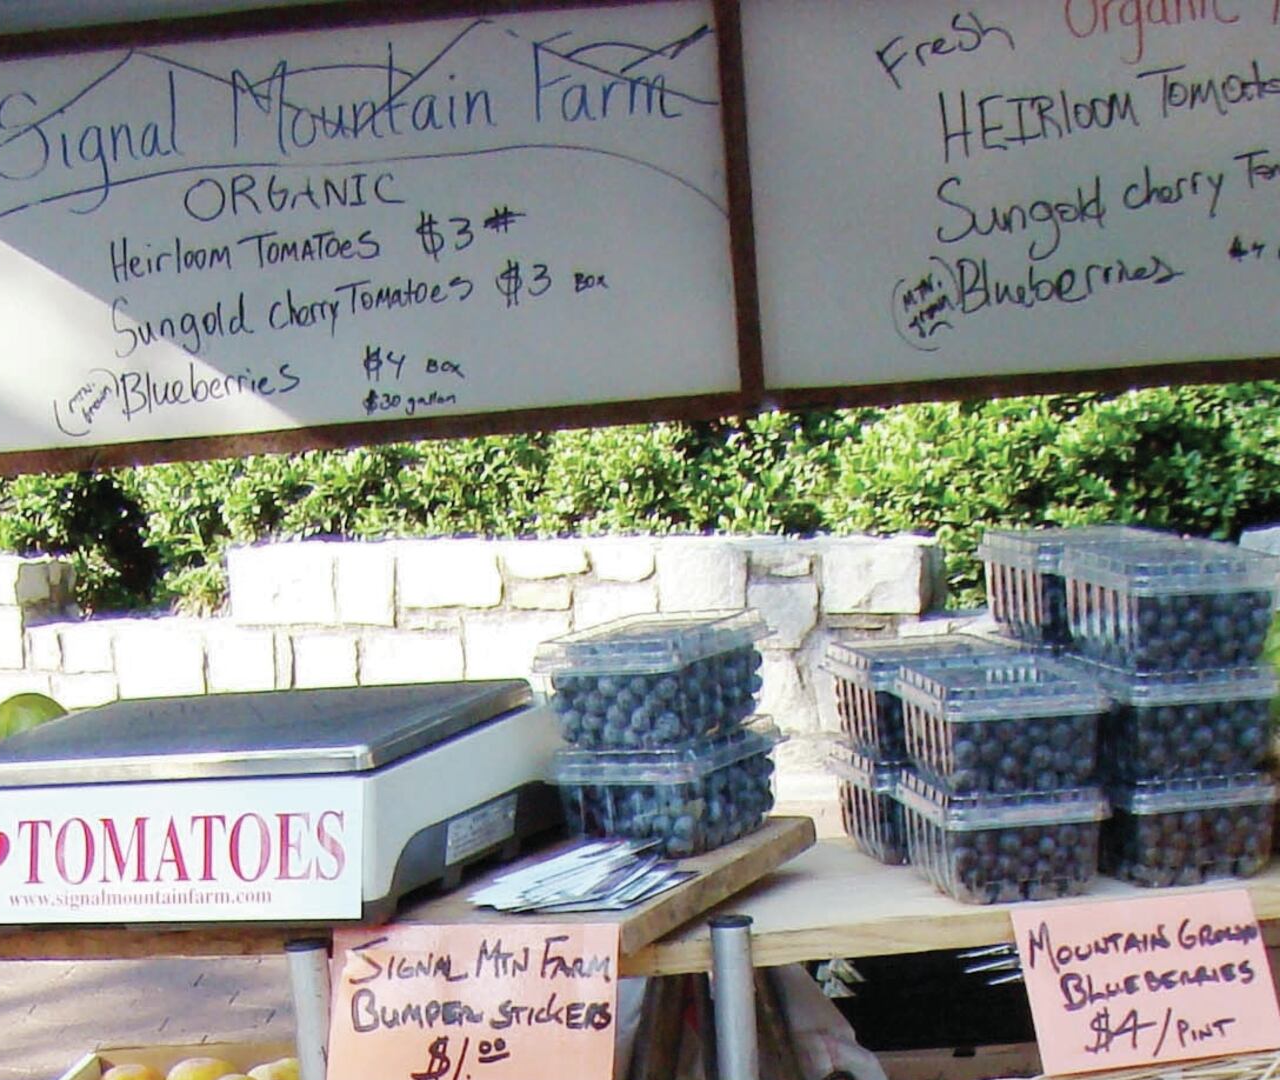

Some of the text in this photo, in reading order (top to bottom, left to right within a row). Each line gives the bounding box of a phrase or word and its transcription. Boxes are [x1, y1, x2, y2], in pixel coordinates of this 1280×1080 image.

[875, 11, 1015, 90] Fresh
[230, 42, 496, 155] Mountain
[531, 31, 682, 123] Farm
[183, 173, 407, 222] ORGANIC
[936, 176, 1107, 261] Sungold
[110, 295, 253, 359] Sungold
[495, 259, 553, 308] $3
[956, 255, 1185, 314] Blueberries
[120, 362, 301, 422] Blueberries
[363, 345, 406, 382] $4
[405, 390, 457, 415] gallon
[17, 809, 347, 885] TOMATOES
[8, 888, 273, 912] www.signalmountainfarm.com
[349, 936, 470, 985] SIGNAL
[540, 935, 612, 983] FARM
[351, 988, 484, 1033] BUMPER
